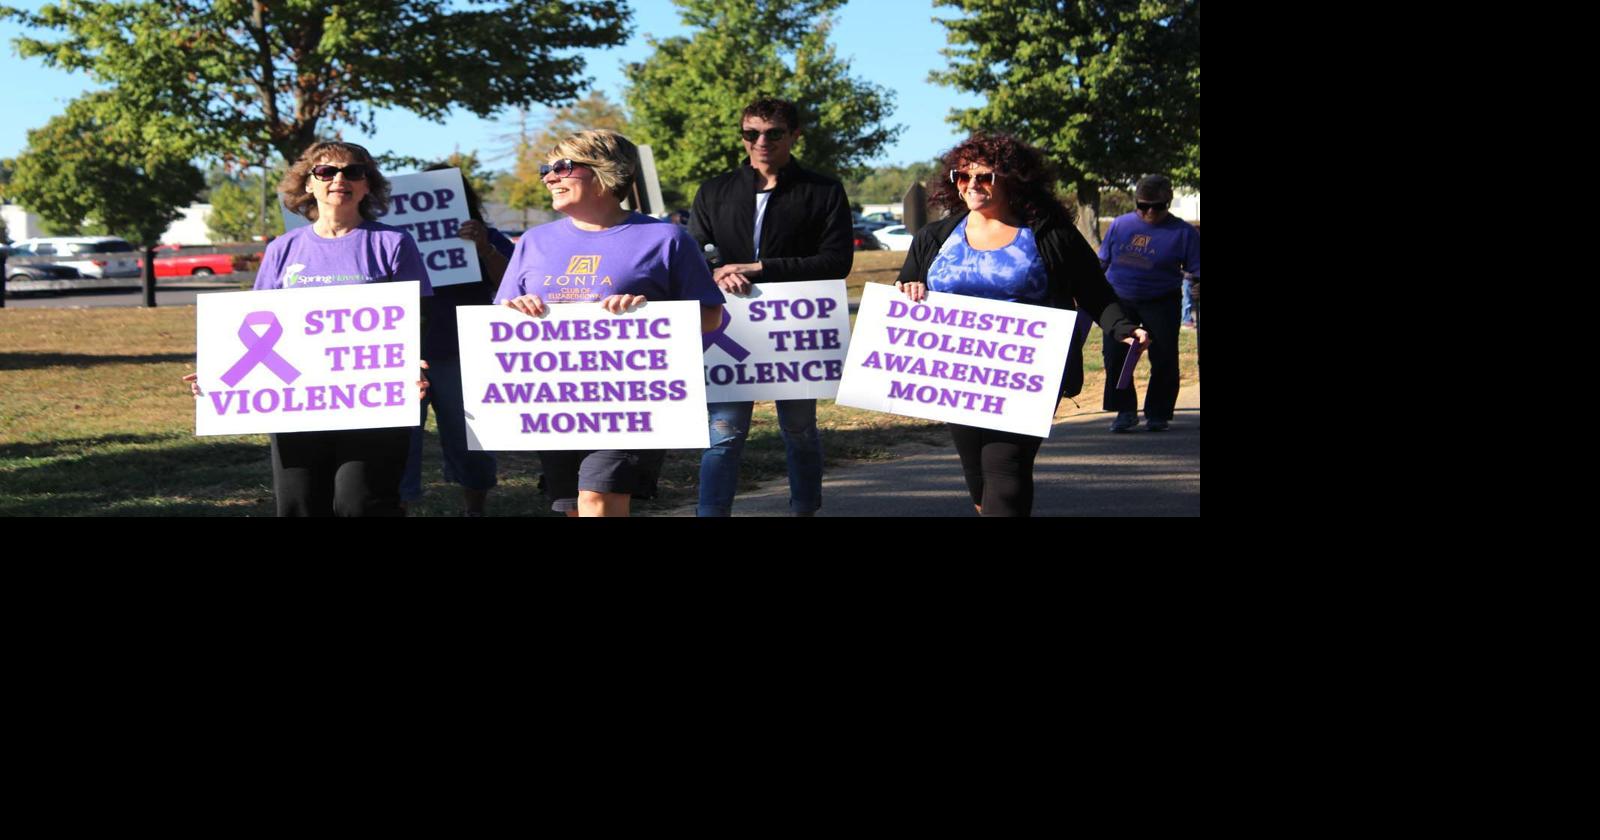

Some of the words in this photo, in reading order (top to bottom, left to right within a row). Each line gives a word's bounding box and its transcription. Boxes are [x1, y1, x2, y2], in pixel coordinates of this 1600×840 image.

[543, 275, 612, 286] ZONTA
[304, 305, 405, 336] STOP
[748, 297, 837, 322] STOP
[886, 300, 1048, 339] DOMESTIC
[489, 317, 671, 342] DOMESTIC
[768, 328, 841, 352] THE
[324, 343, 406, 372] THE
[885, 326, 1037, 365] VIOLENCE
[495, 349, 669, 373] VIOLENCE
[861, 350, 1045, 393] AWARENESS
[208, 381, 406, 416] VIOLENCE
[481, 379, 688, 404] AWARENESS
[887, 380, 1007, 415] MONTH
[520, 411, 653, 434] MONTH
